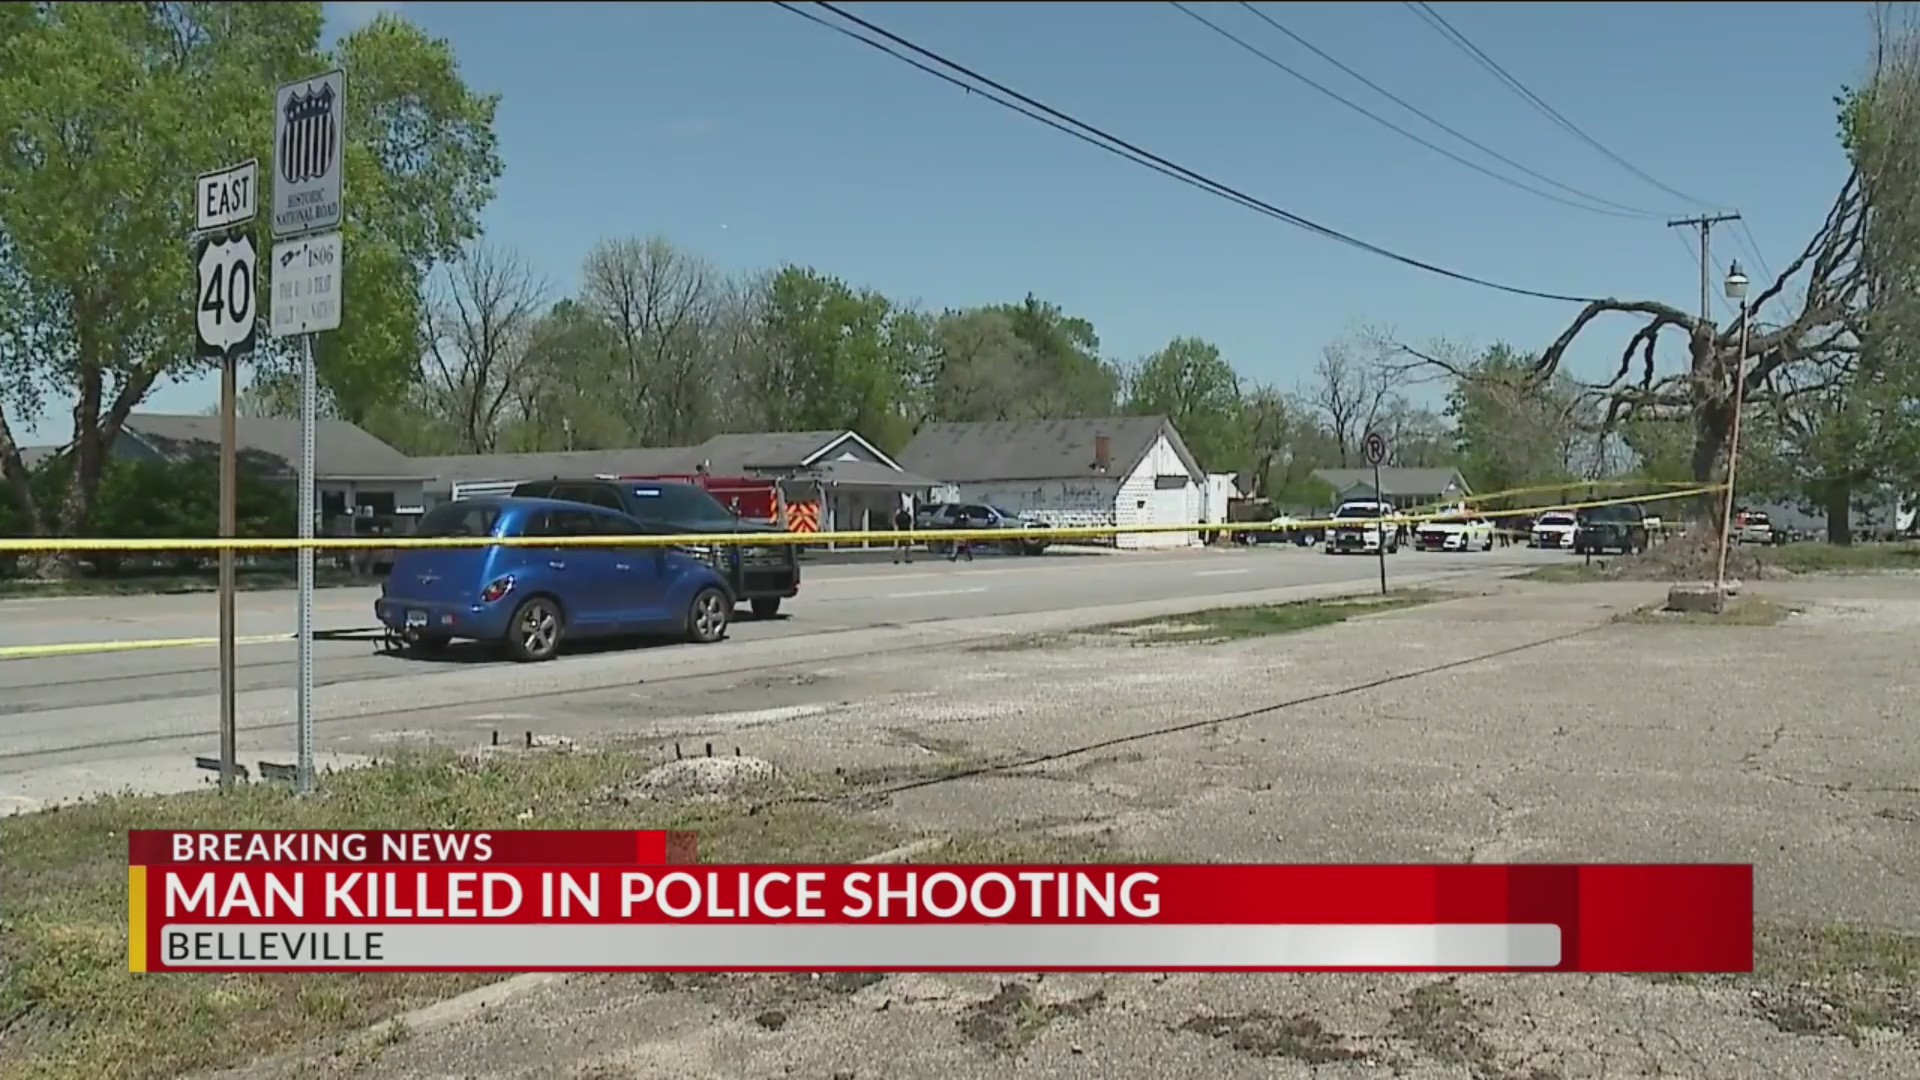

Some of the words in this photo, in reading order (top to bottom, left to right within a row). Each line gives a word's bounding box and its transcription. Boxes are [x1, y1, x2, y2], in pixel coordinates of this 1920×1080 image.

[207, 176, 249, 217] EAST
[287, 188, 325, 208] HISTORIC
[276, 206, 312, 225] NATIONAL
[315, 202, 338, 218] ROAD
[308, 244, 334, 267] 1806
[202, 258, 250, 325] 40
